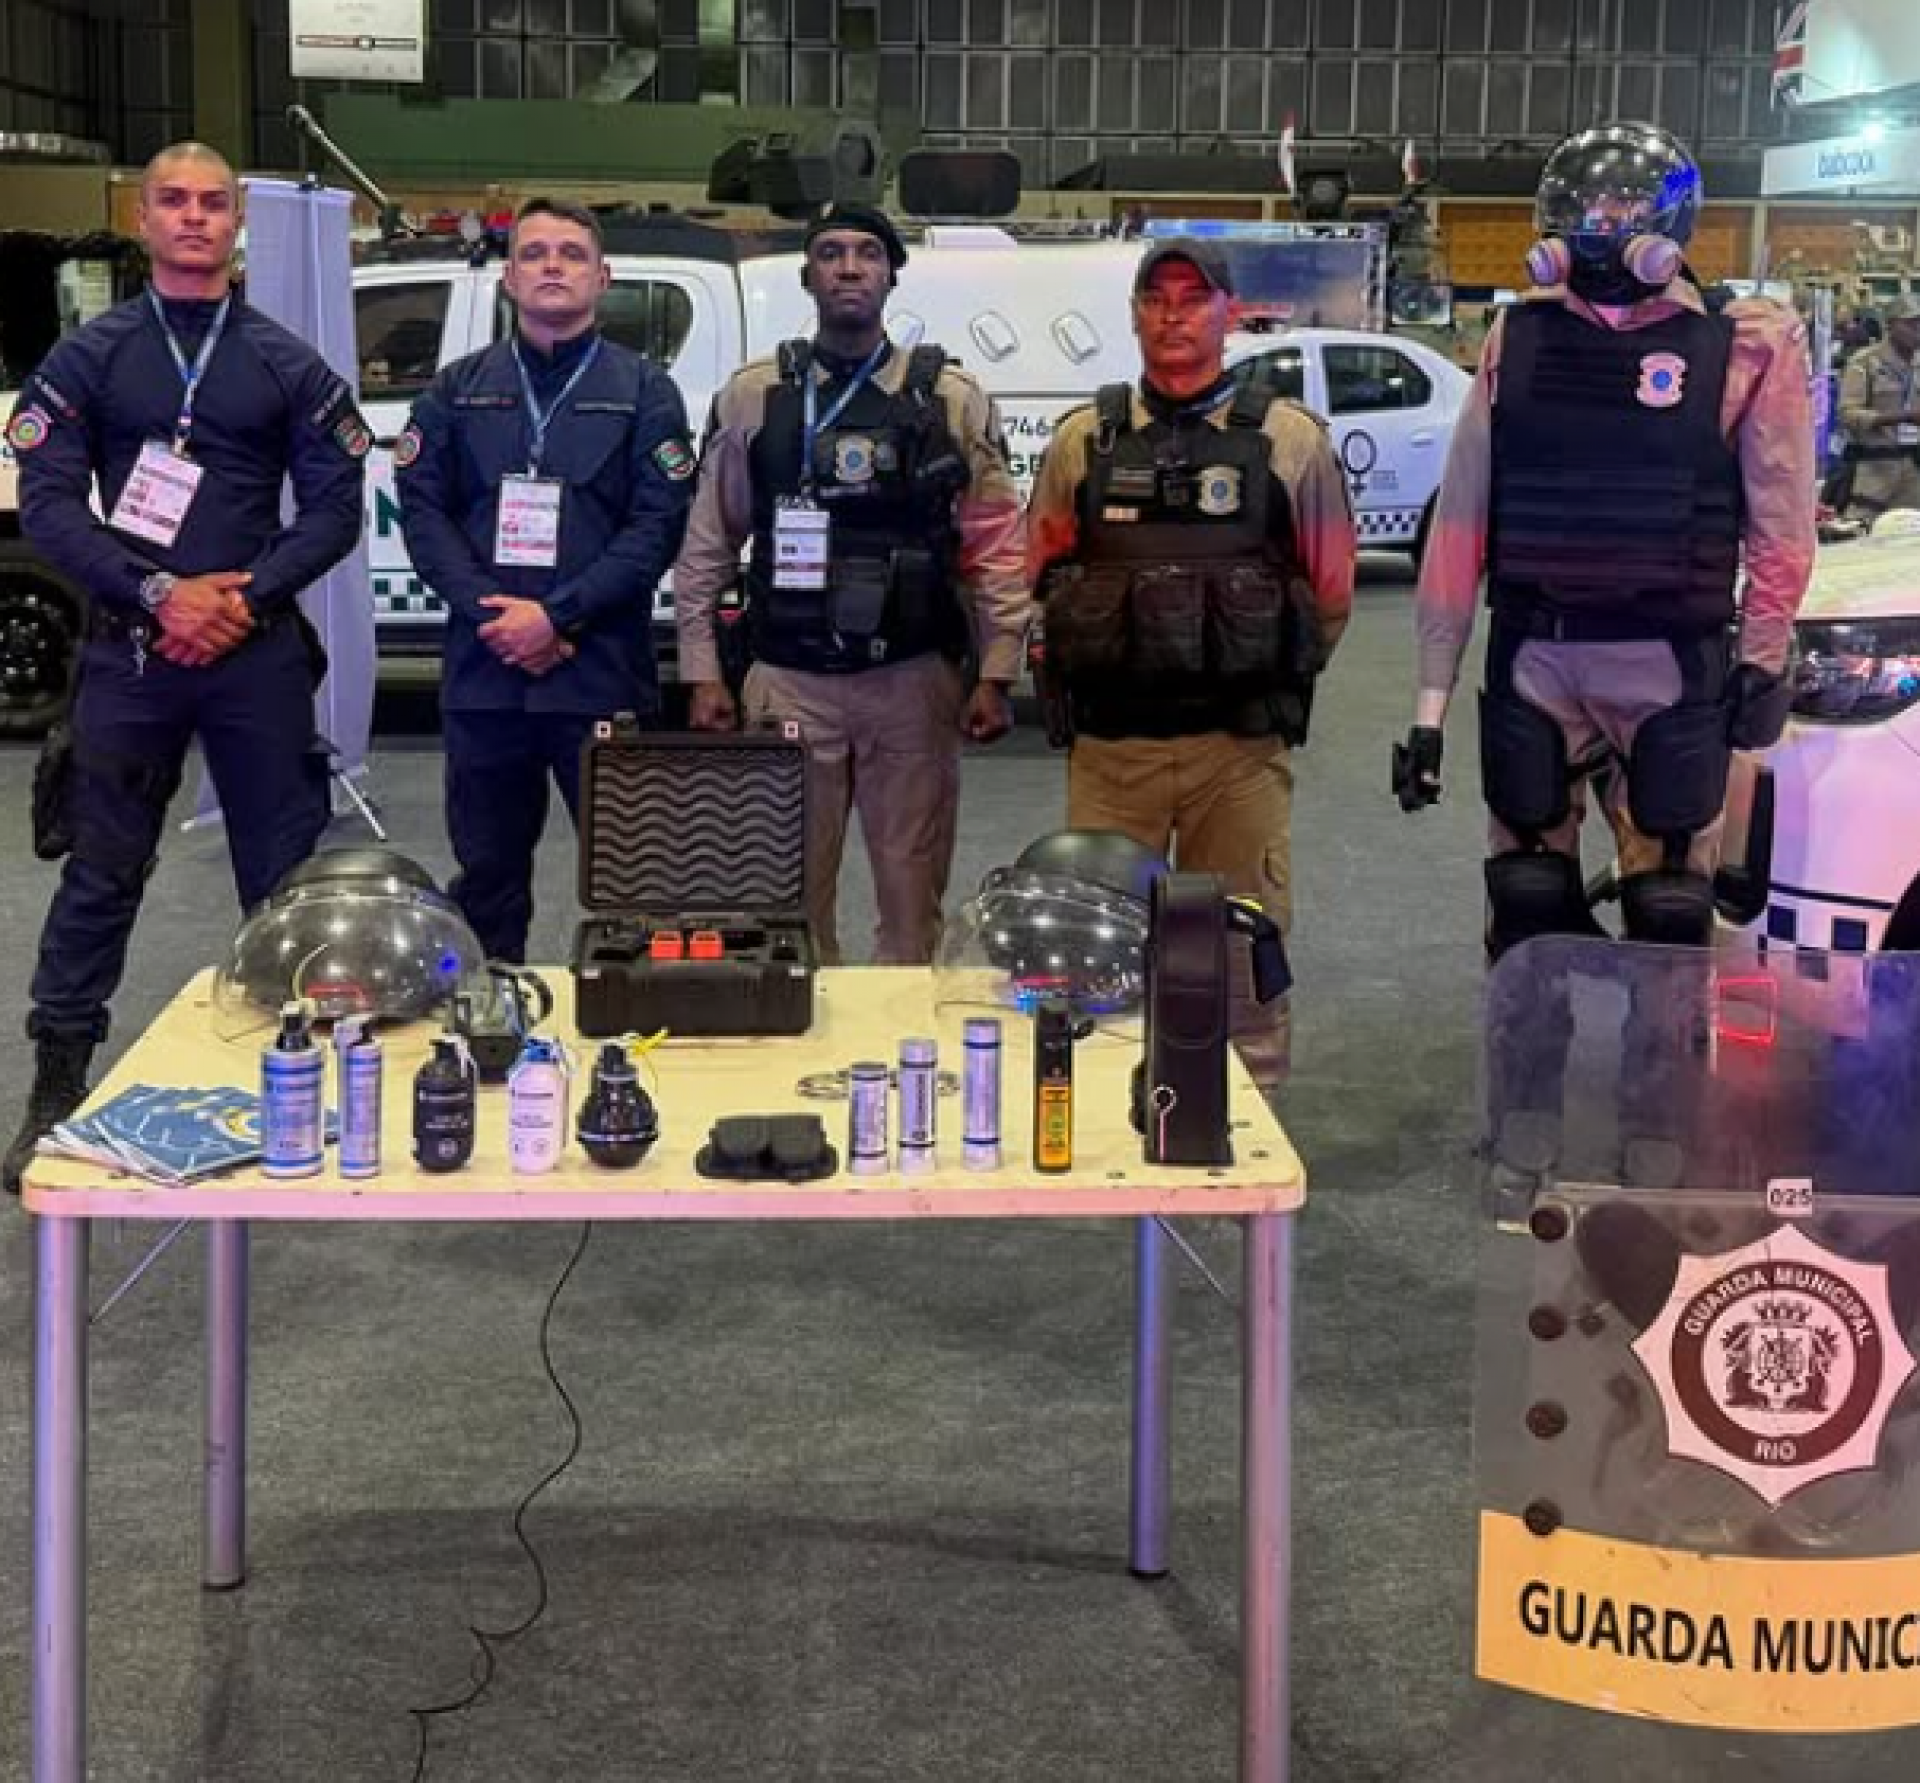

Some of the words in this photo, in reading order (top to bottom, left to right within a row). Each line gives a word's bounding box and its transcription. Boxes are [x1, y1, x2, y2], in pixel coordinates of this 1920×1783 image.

[1769, 1187, 1812, 1208] 025
[1684, 1270, 1769, 1335] GUARDA
[1774, 1267, 1873, 1347] MUNICIPAL
[1754, 1439, 1797, 1461] RIO
[1519, 1581, 1734, 1671] GUARDA
[1752, 1613, 1920, 1674] MUNIC
